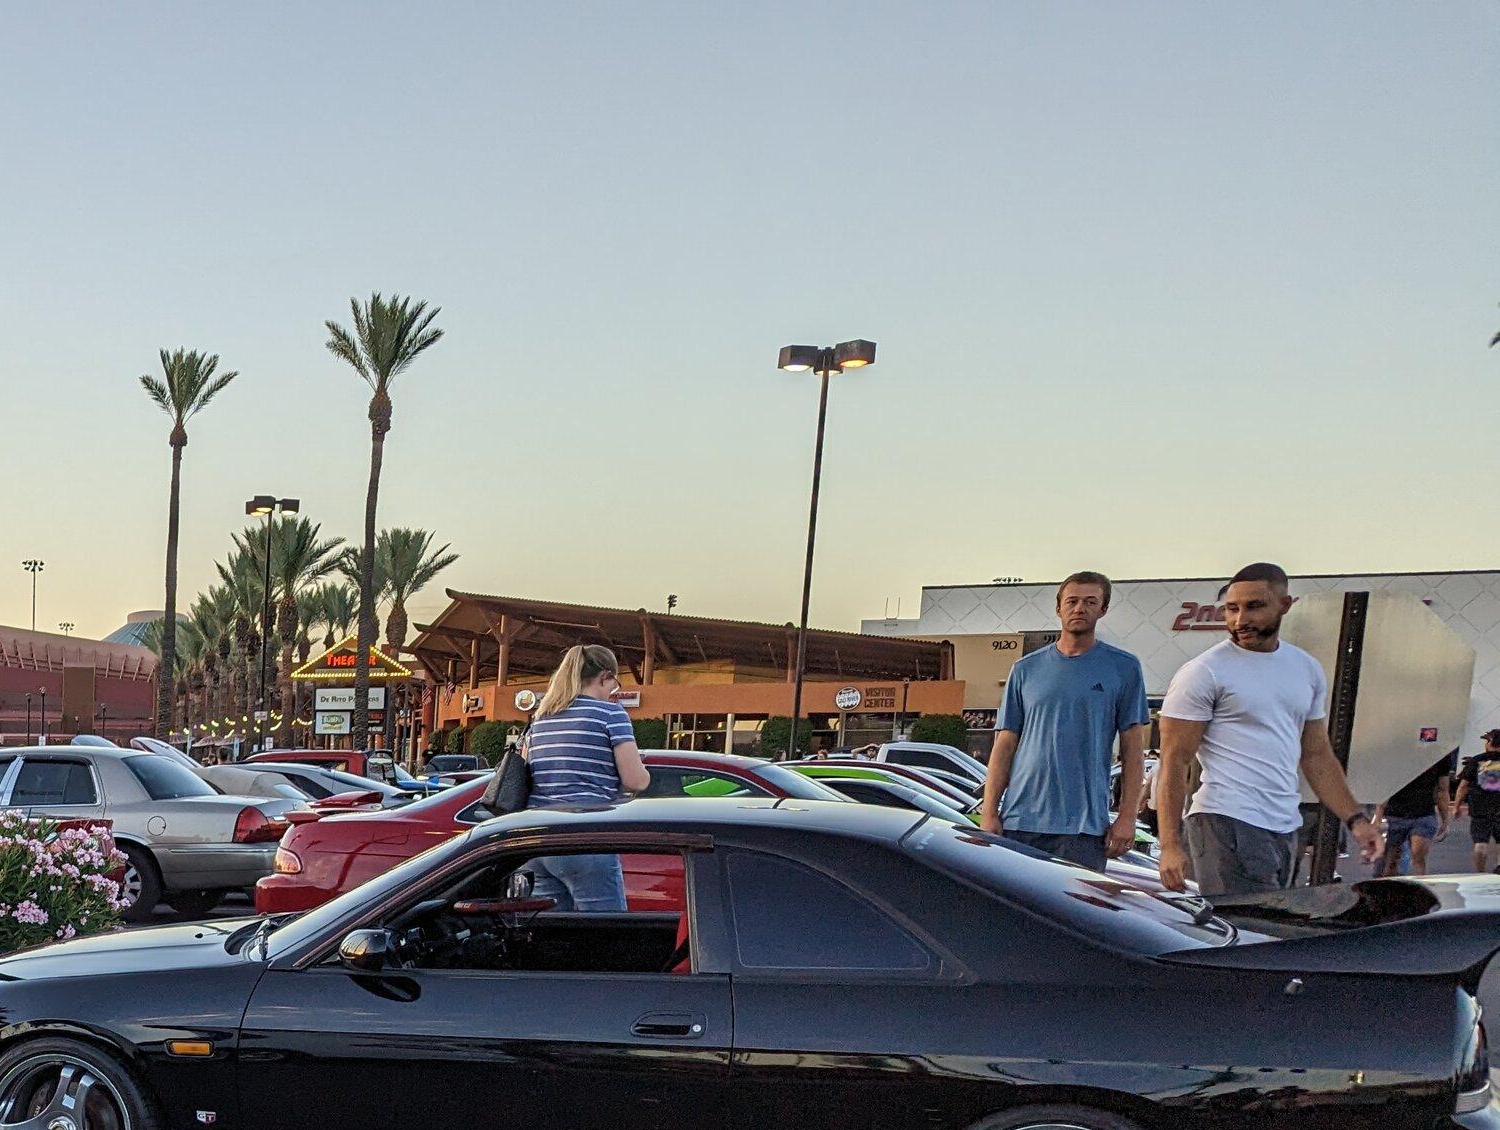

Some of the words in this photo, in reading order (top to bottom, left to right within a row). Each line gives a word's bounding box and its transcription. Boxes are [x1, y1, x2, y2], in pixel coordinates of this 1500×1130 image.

[992, 640, 1018, 651] 9120
[327, 652, 377, 666] THEAR
[864, 687, 896, 697] VISITOR
[864, 698, 895, 708] CENTER
[197, 1112, 215, 1122] GT
